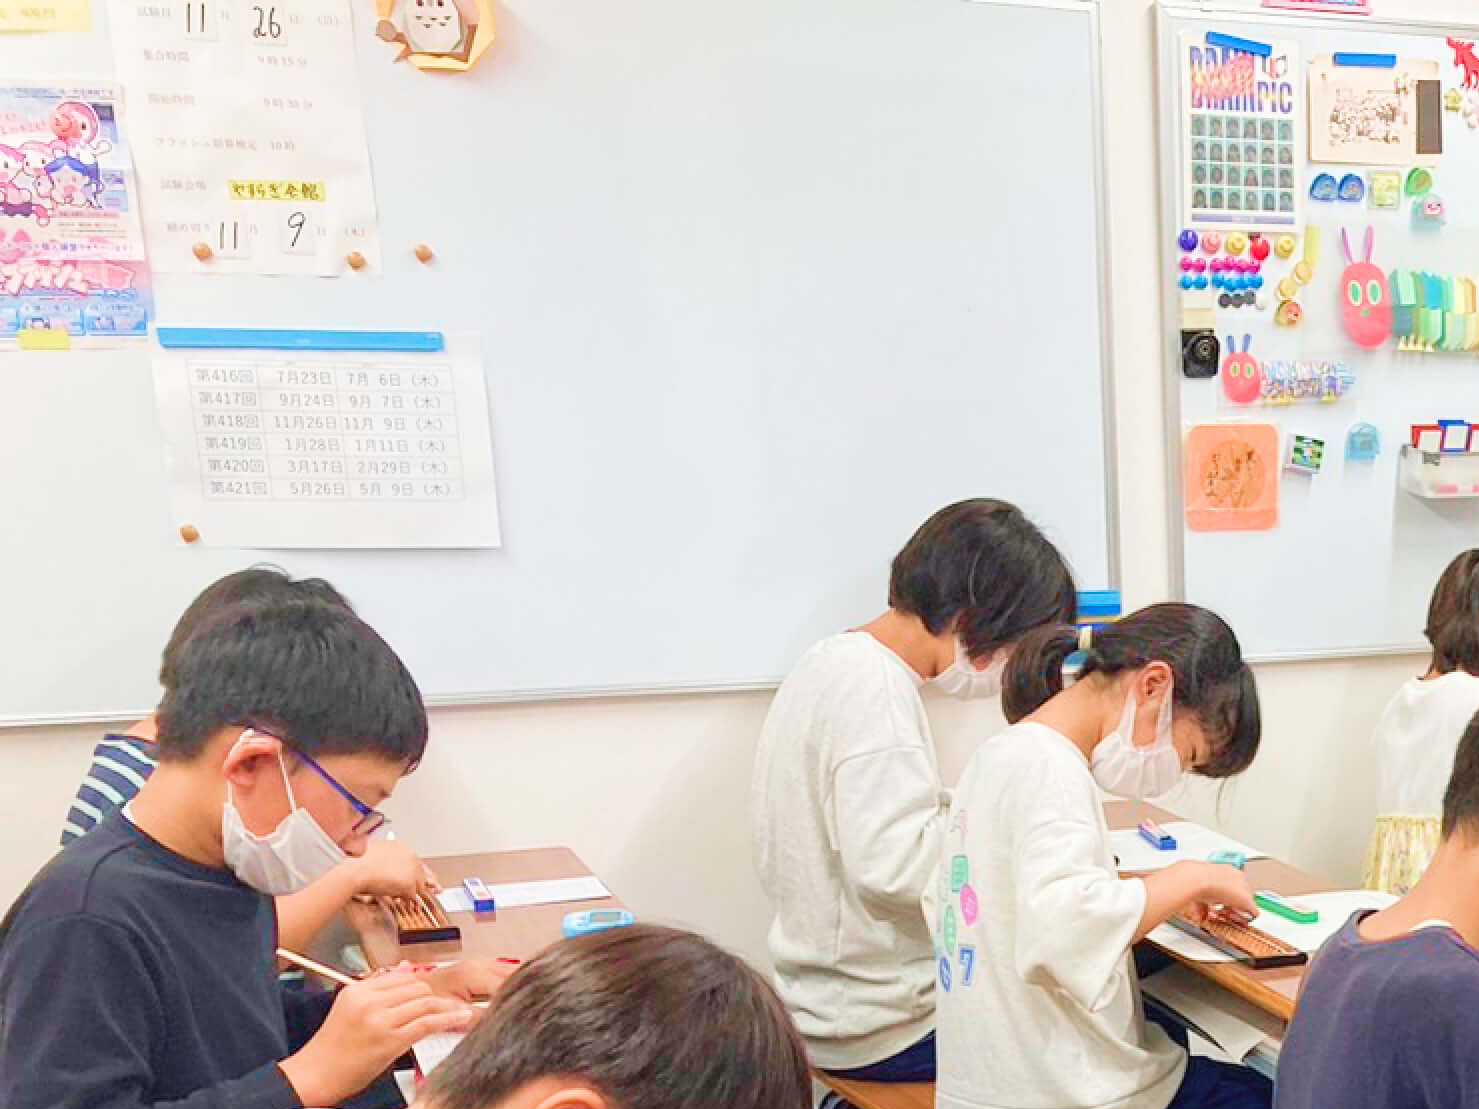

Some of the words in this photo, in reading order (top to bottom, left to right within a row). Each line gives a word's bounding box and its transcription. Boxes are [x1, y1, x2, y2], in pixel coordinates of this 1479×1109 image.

[185, 2, 206, 33] 11
[252, 6, 282, 38] 26
[219, 220, 240, 250] 11
[288, 211, 307, 248] 9
[278, 370, 332, 384] 7月23日
[280, 393, 335, 407] 9月24日
[274, 415, 336, 429] 11月26日
[286, 438, 338, 451] 1月28日
[287, 460, 342, 473] 3月17日
[290, 482, 344, 496] 5月26日
